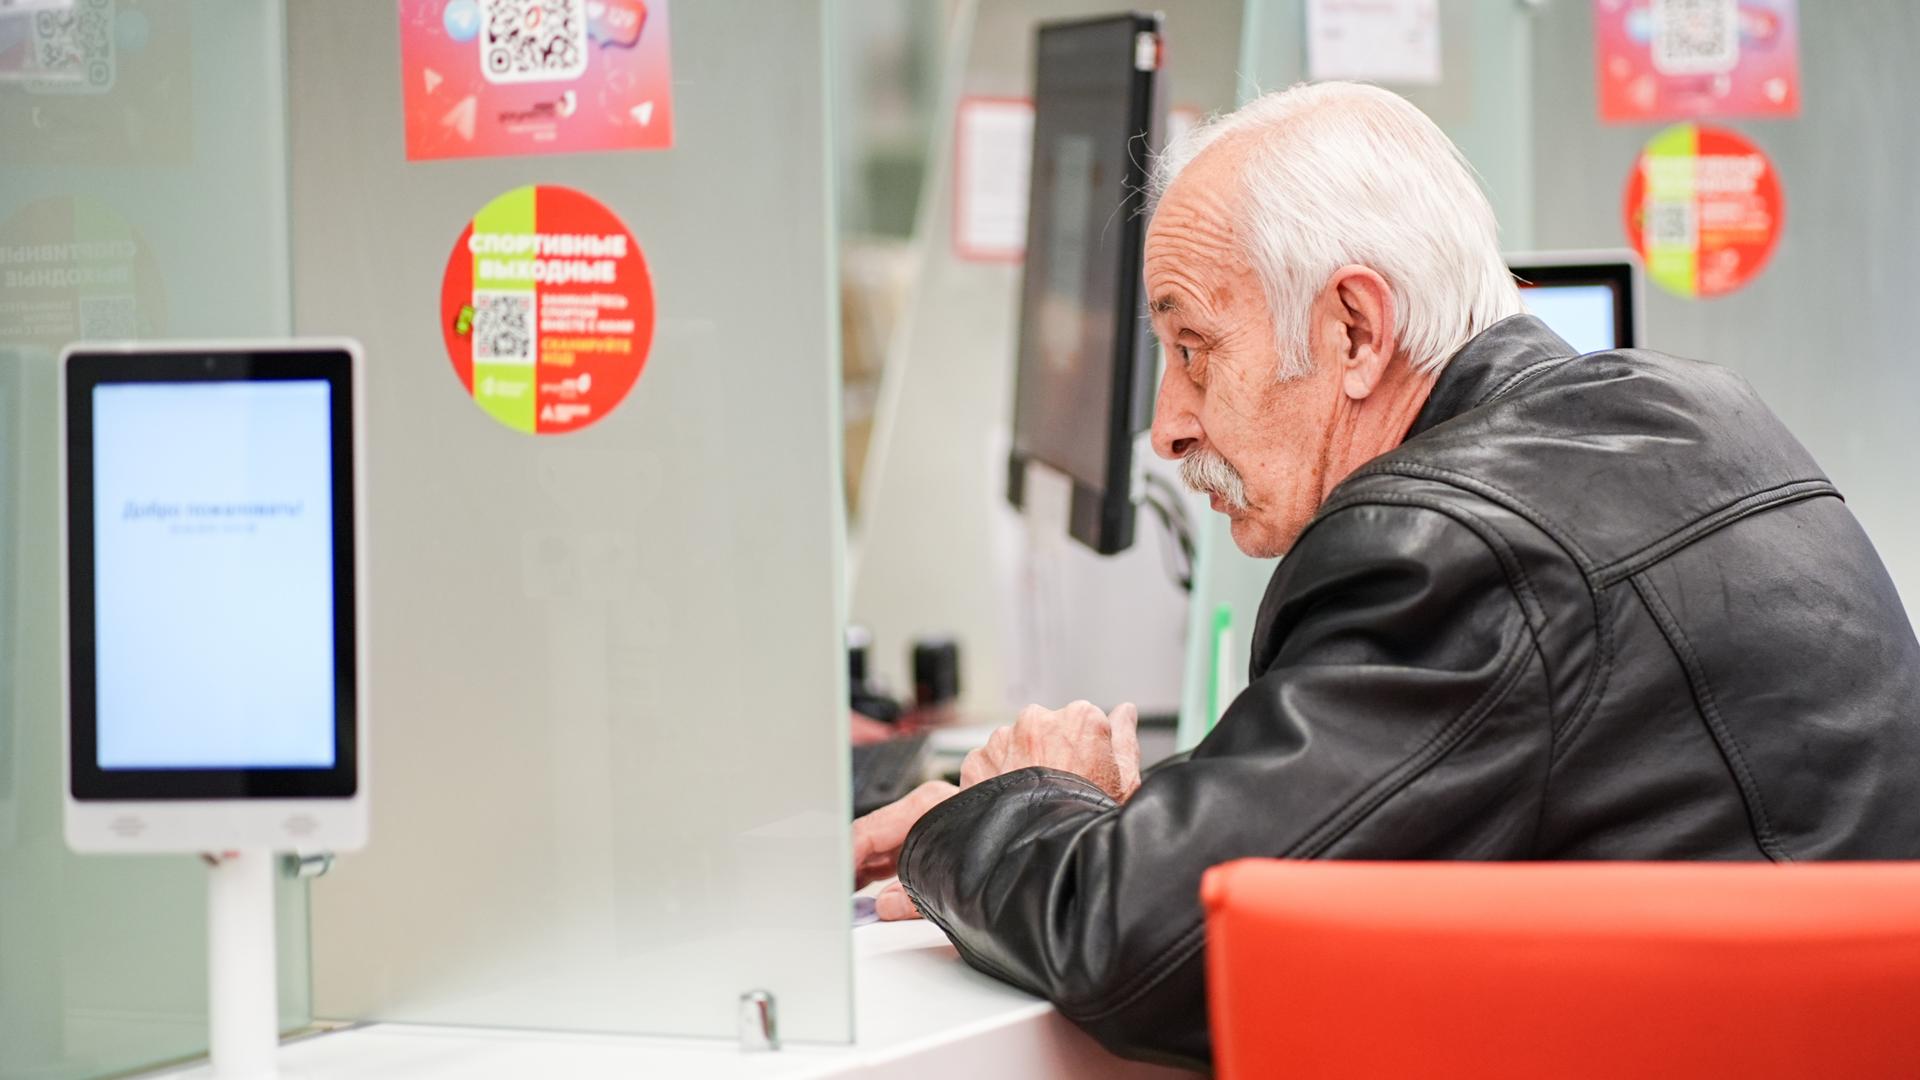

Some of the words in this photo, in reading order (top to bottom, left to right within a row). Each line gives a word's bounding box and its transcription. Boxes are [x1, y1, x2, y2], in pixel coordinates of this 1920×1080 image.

[469, 233, 627, 258] СПОРТИВНЫЕ
[479, 259, 616, 285] ВЫХОДНЫЕ
[123, 498, 179, 520] Добро
